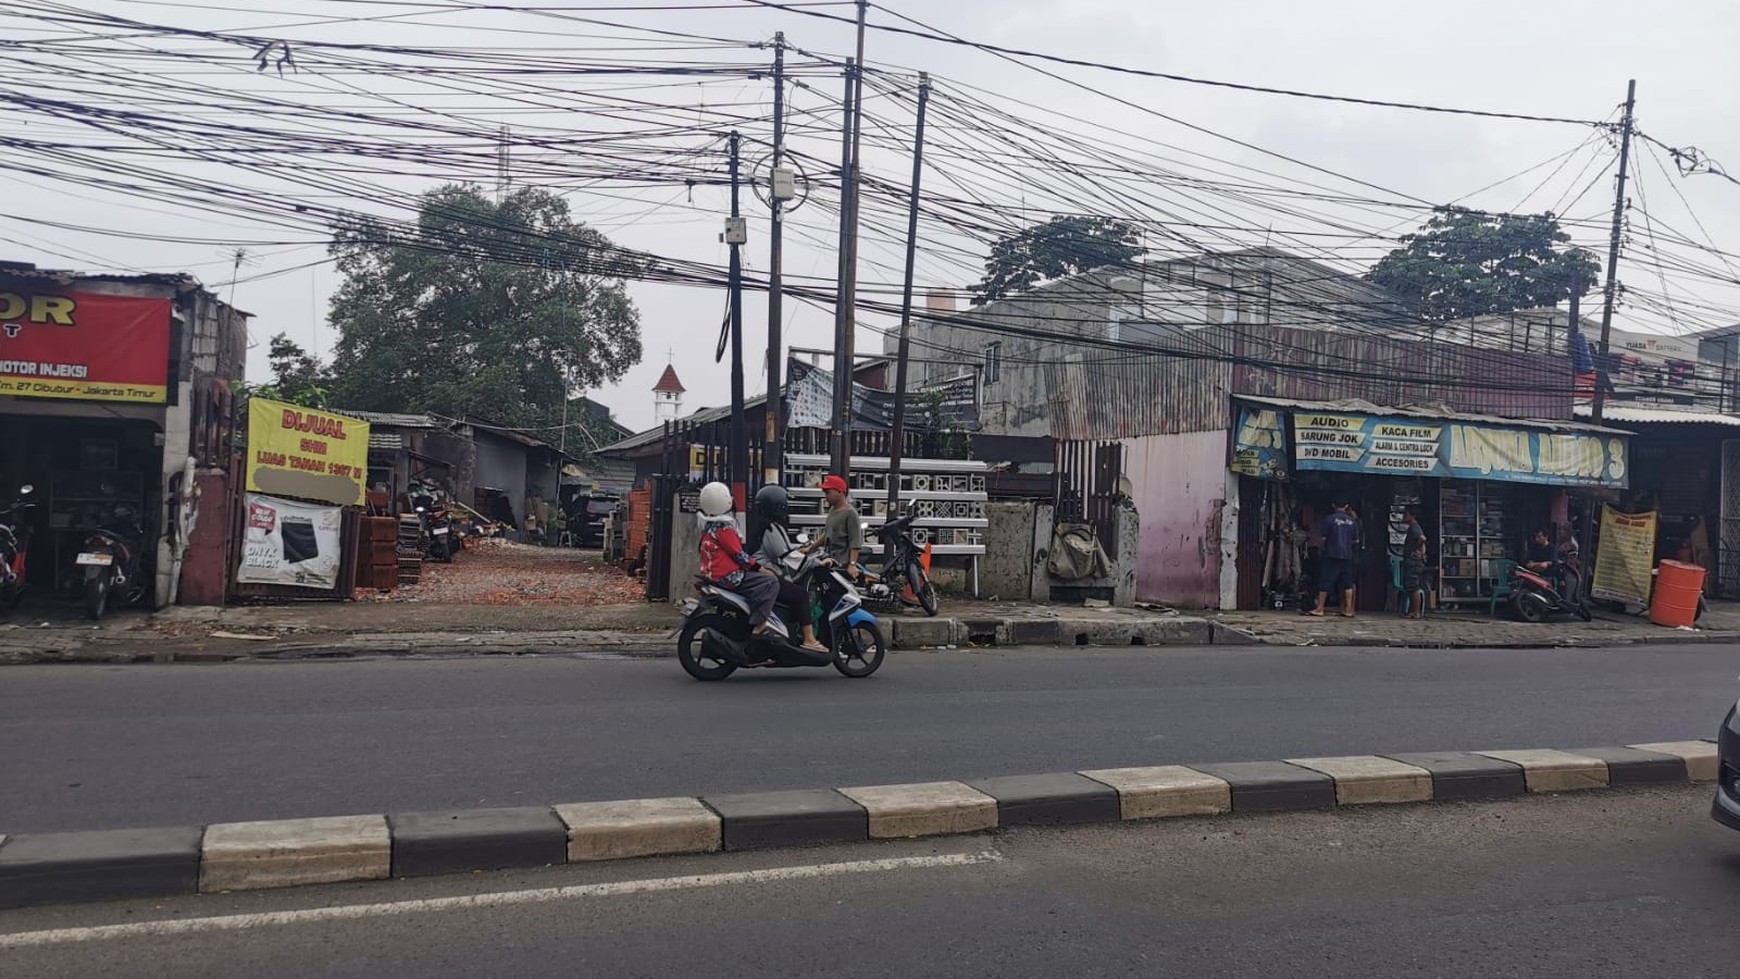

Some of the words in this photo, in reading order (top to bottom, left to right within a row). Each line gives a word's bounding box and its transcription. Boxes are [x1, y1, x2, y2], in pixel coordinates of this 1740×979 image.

[1626, 341, 1646, 349] YUASA
[40, 363, 88, 378] INJEKSI
[17, 382, 31, 391] 27
[33, 383, 74, 393] Cibubur
[82, 386, 125, 397] Jakarta
[127, 388, 157, 398] Timur
[281, 408, 347, 440] DIJUAL
[1310, 417, 1349, 428] AUDIO
[1300, 431, 1336, 442] SARUNG
[1338, 434, 1358, 443] JOK
[1381, 426, 1408, 437] KACA
[1410, 428, 1432, 438] FILM
[256, 450, 287, 467] LUAS
[1321, 448, 1350, 459] MOBIL
[1375, 457, 1429, 469] ACCESORIES
